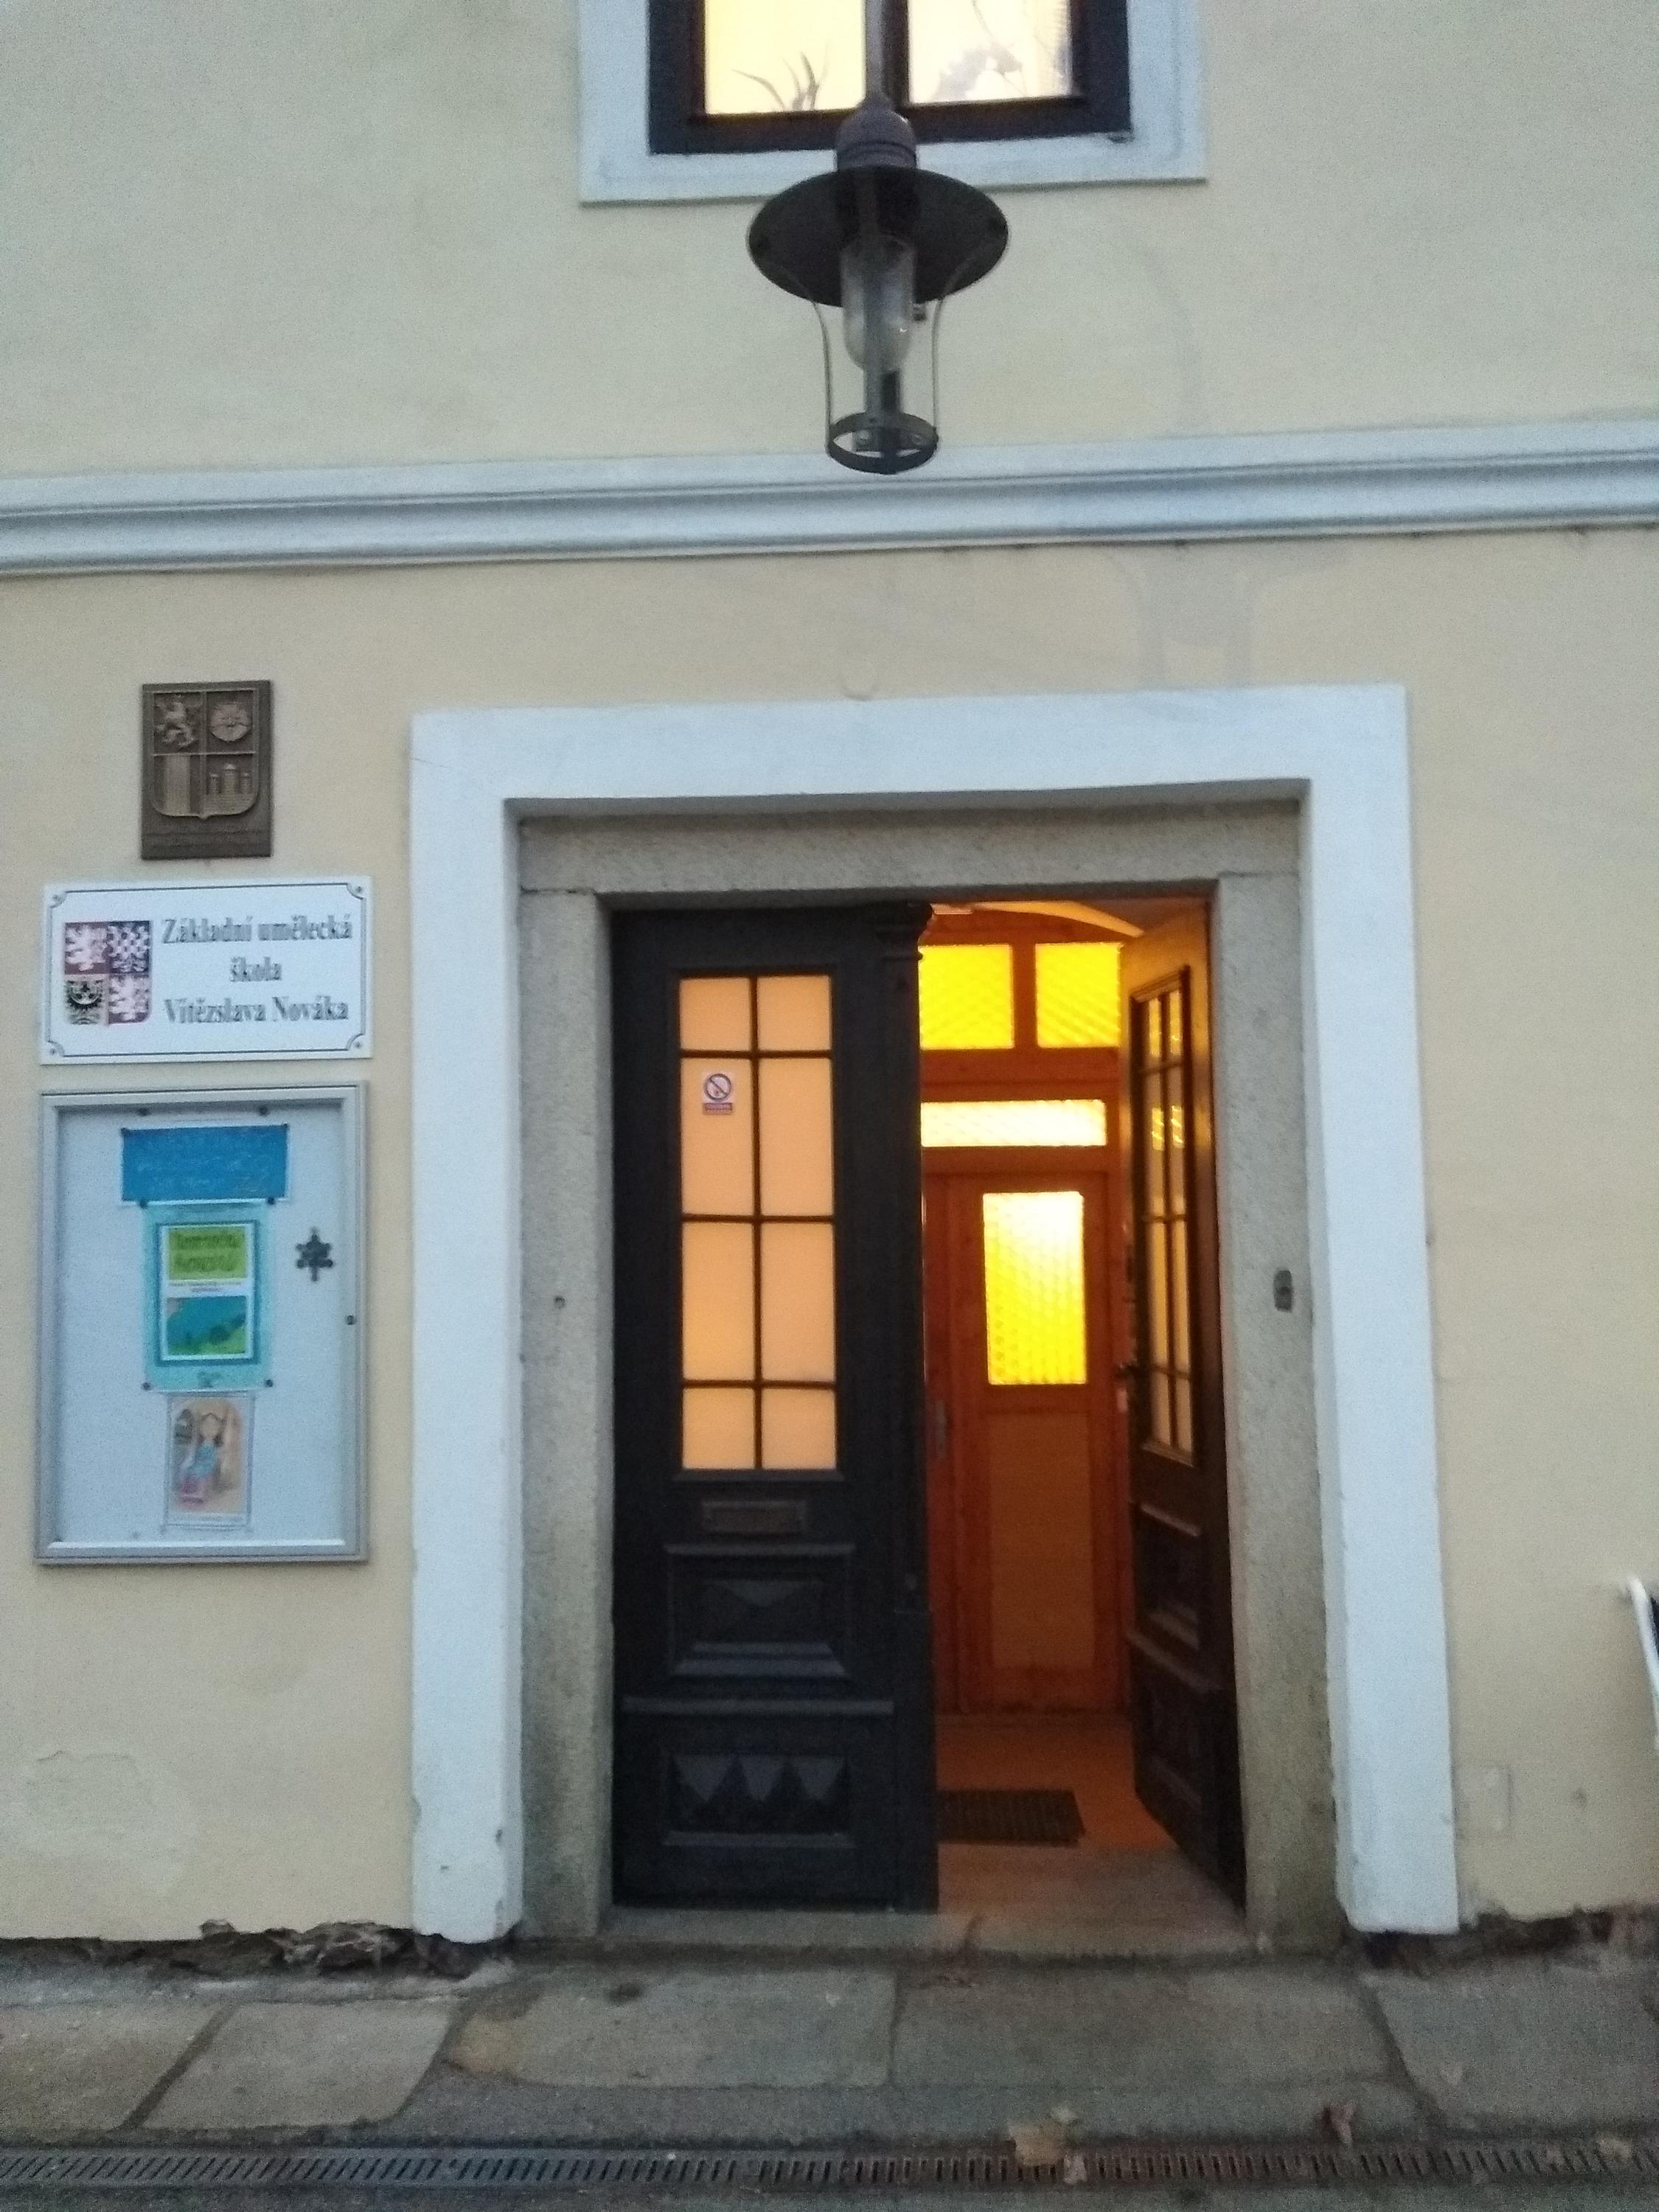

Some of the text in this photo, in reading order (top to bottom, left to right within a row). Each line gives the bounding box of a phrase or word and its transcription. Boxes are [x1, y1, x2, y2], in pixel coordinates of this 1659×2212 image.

[161, 914, 253, 944] Základní
[230, 956, 282, 982] škola
[163, 995, 349, 1023] Vítězslava Nováka
